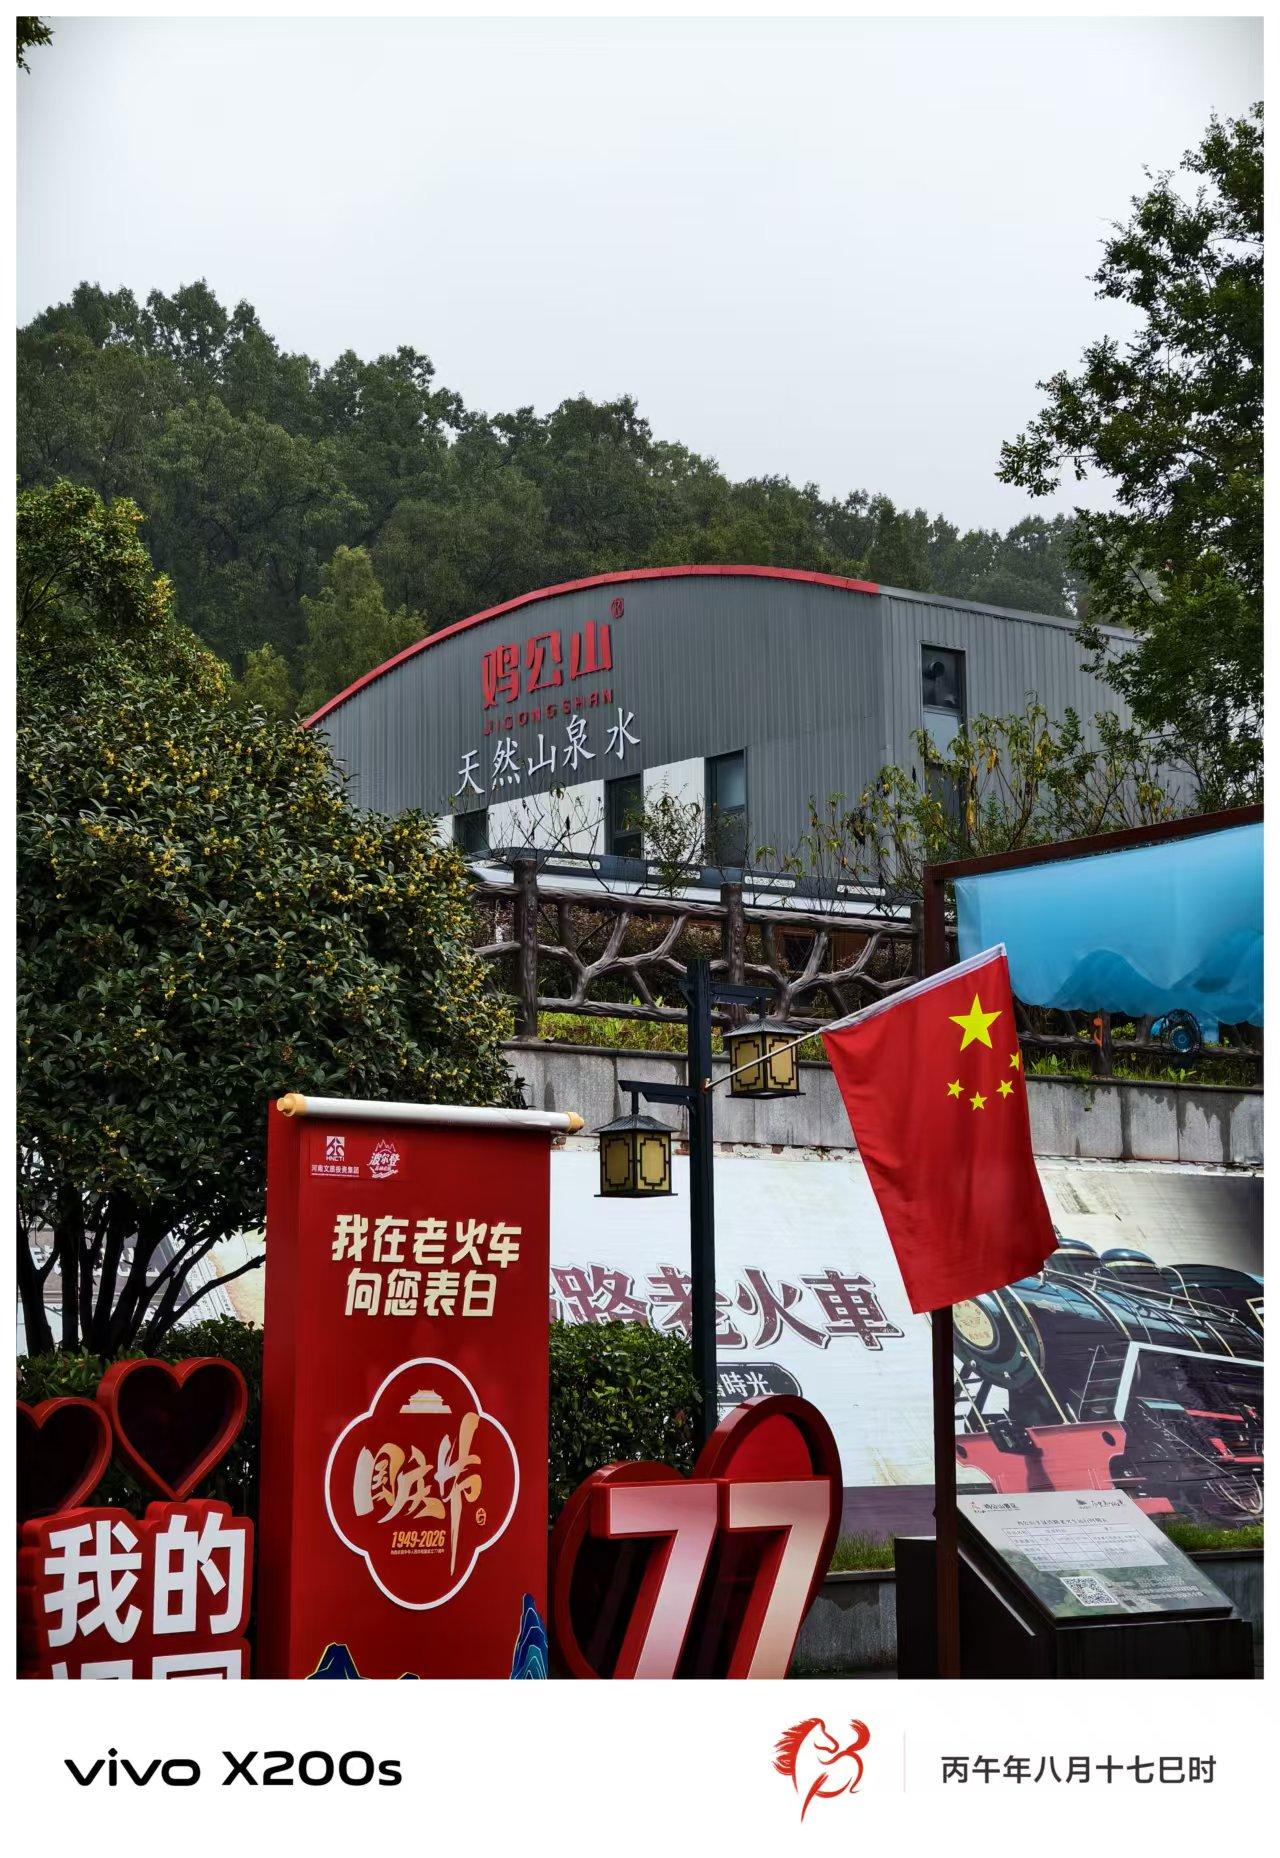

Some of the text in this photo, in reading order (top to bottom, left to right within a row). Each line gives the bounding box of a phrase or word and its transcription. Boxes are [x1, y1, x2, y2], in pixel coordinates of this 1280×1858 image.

[481, 620, 613, 710] 鸡公山
[455, 707, 642, 797] 天然山泉水
[483, 688, 614, 736] JIGONGSHAN
[332, 1213, 522, 1268] 我在老火车
[344, 1267, 497, 1317] 向您表白
[549, 1262, 905, 1351] 路老火車
[353, 1412, 483, 1576] 国庆节
[43, 1511, 246, 1648] 我的
[391, 1530, 446, 1548] 1949-2026
[609, 1479, 831, 1679] 77
